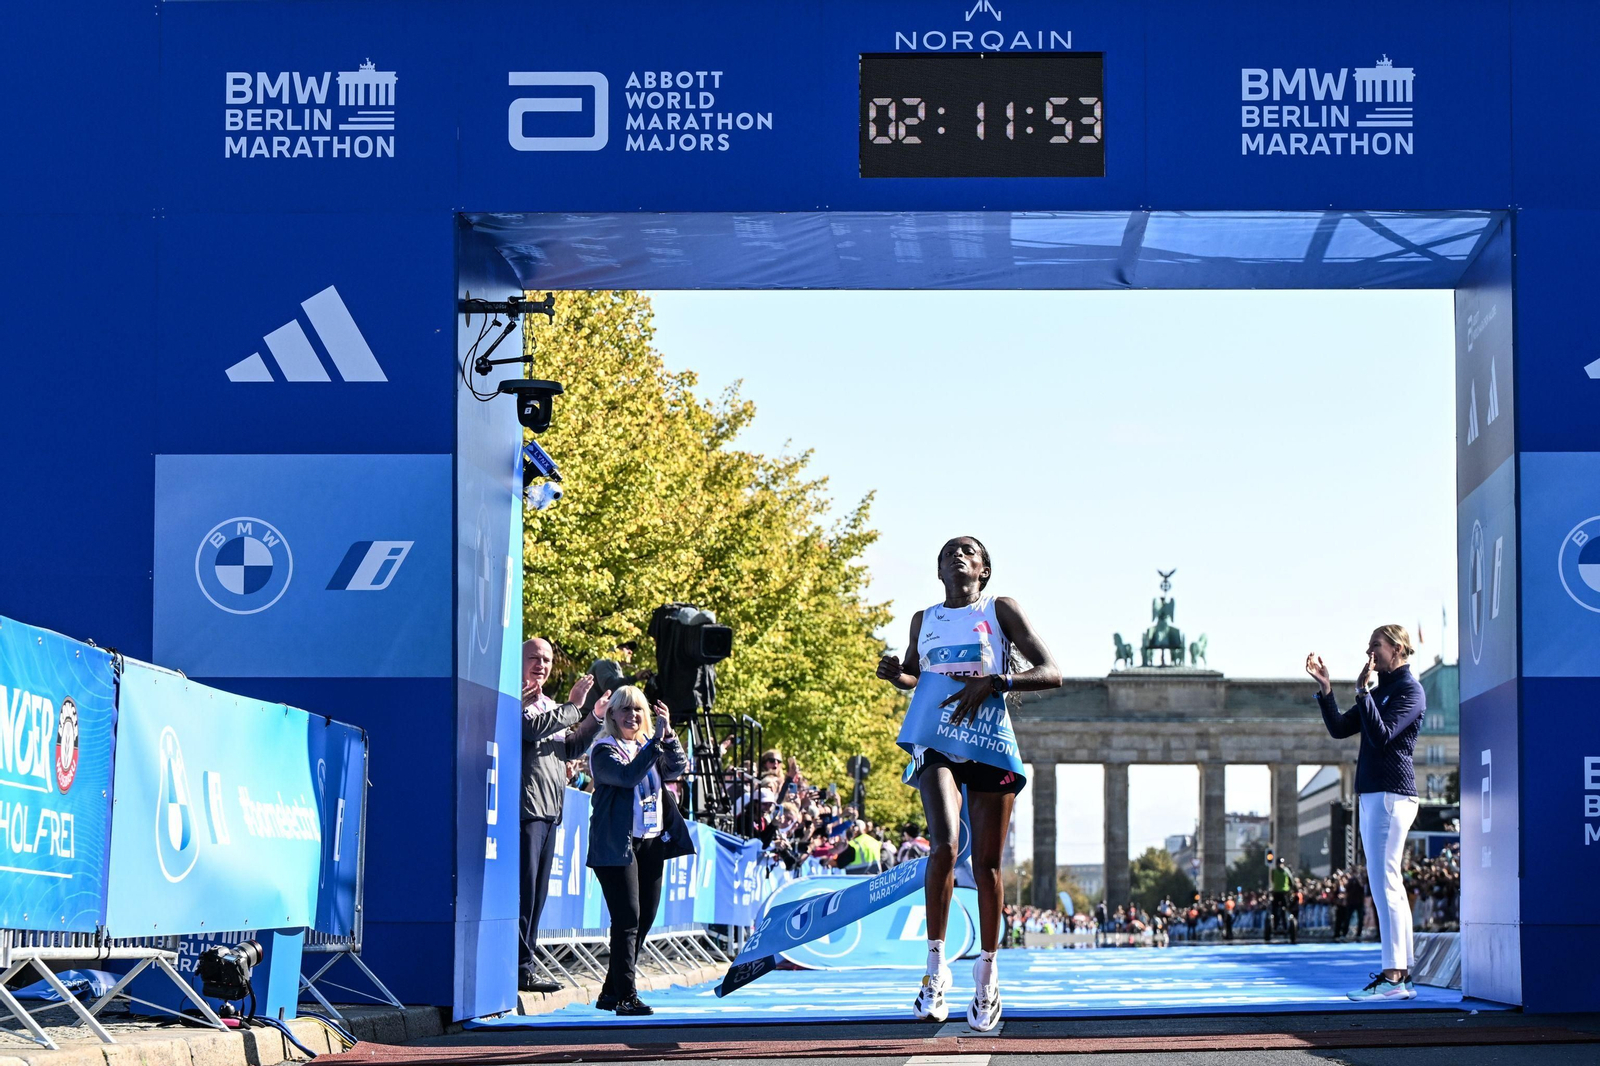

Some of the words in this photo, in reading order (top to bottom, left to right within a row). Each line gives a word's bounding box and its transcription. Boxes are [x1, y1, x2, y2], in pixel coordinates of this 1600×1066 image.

[895, 30, 1072, 51] NORQAIN
[225, 71, 332, 105] BMW
[625, 71, 723, 89] ABBOTT
[1241, 67, 1349, 101] BMW
[625, 91, 715, 110] WORLD
[225, 108, 332, 131] BERLIN
[625, 112, 773, 131] MARATHON
[1241, 105, 1349, 128] BERLIN
[225, 135, 395, 159] MARATHON
[625, 133, 730, 152] MAJORS
[1241, 132, 1414, 155] MARATHON
[533, 450, 550, 468] LYNX
[209, 522, 280, 549] BMW
[936, 724, 1014, 756] MARATHON
[869, 871, 897, 892] BERLIN
